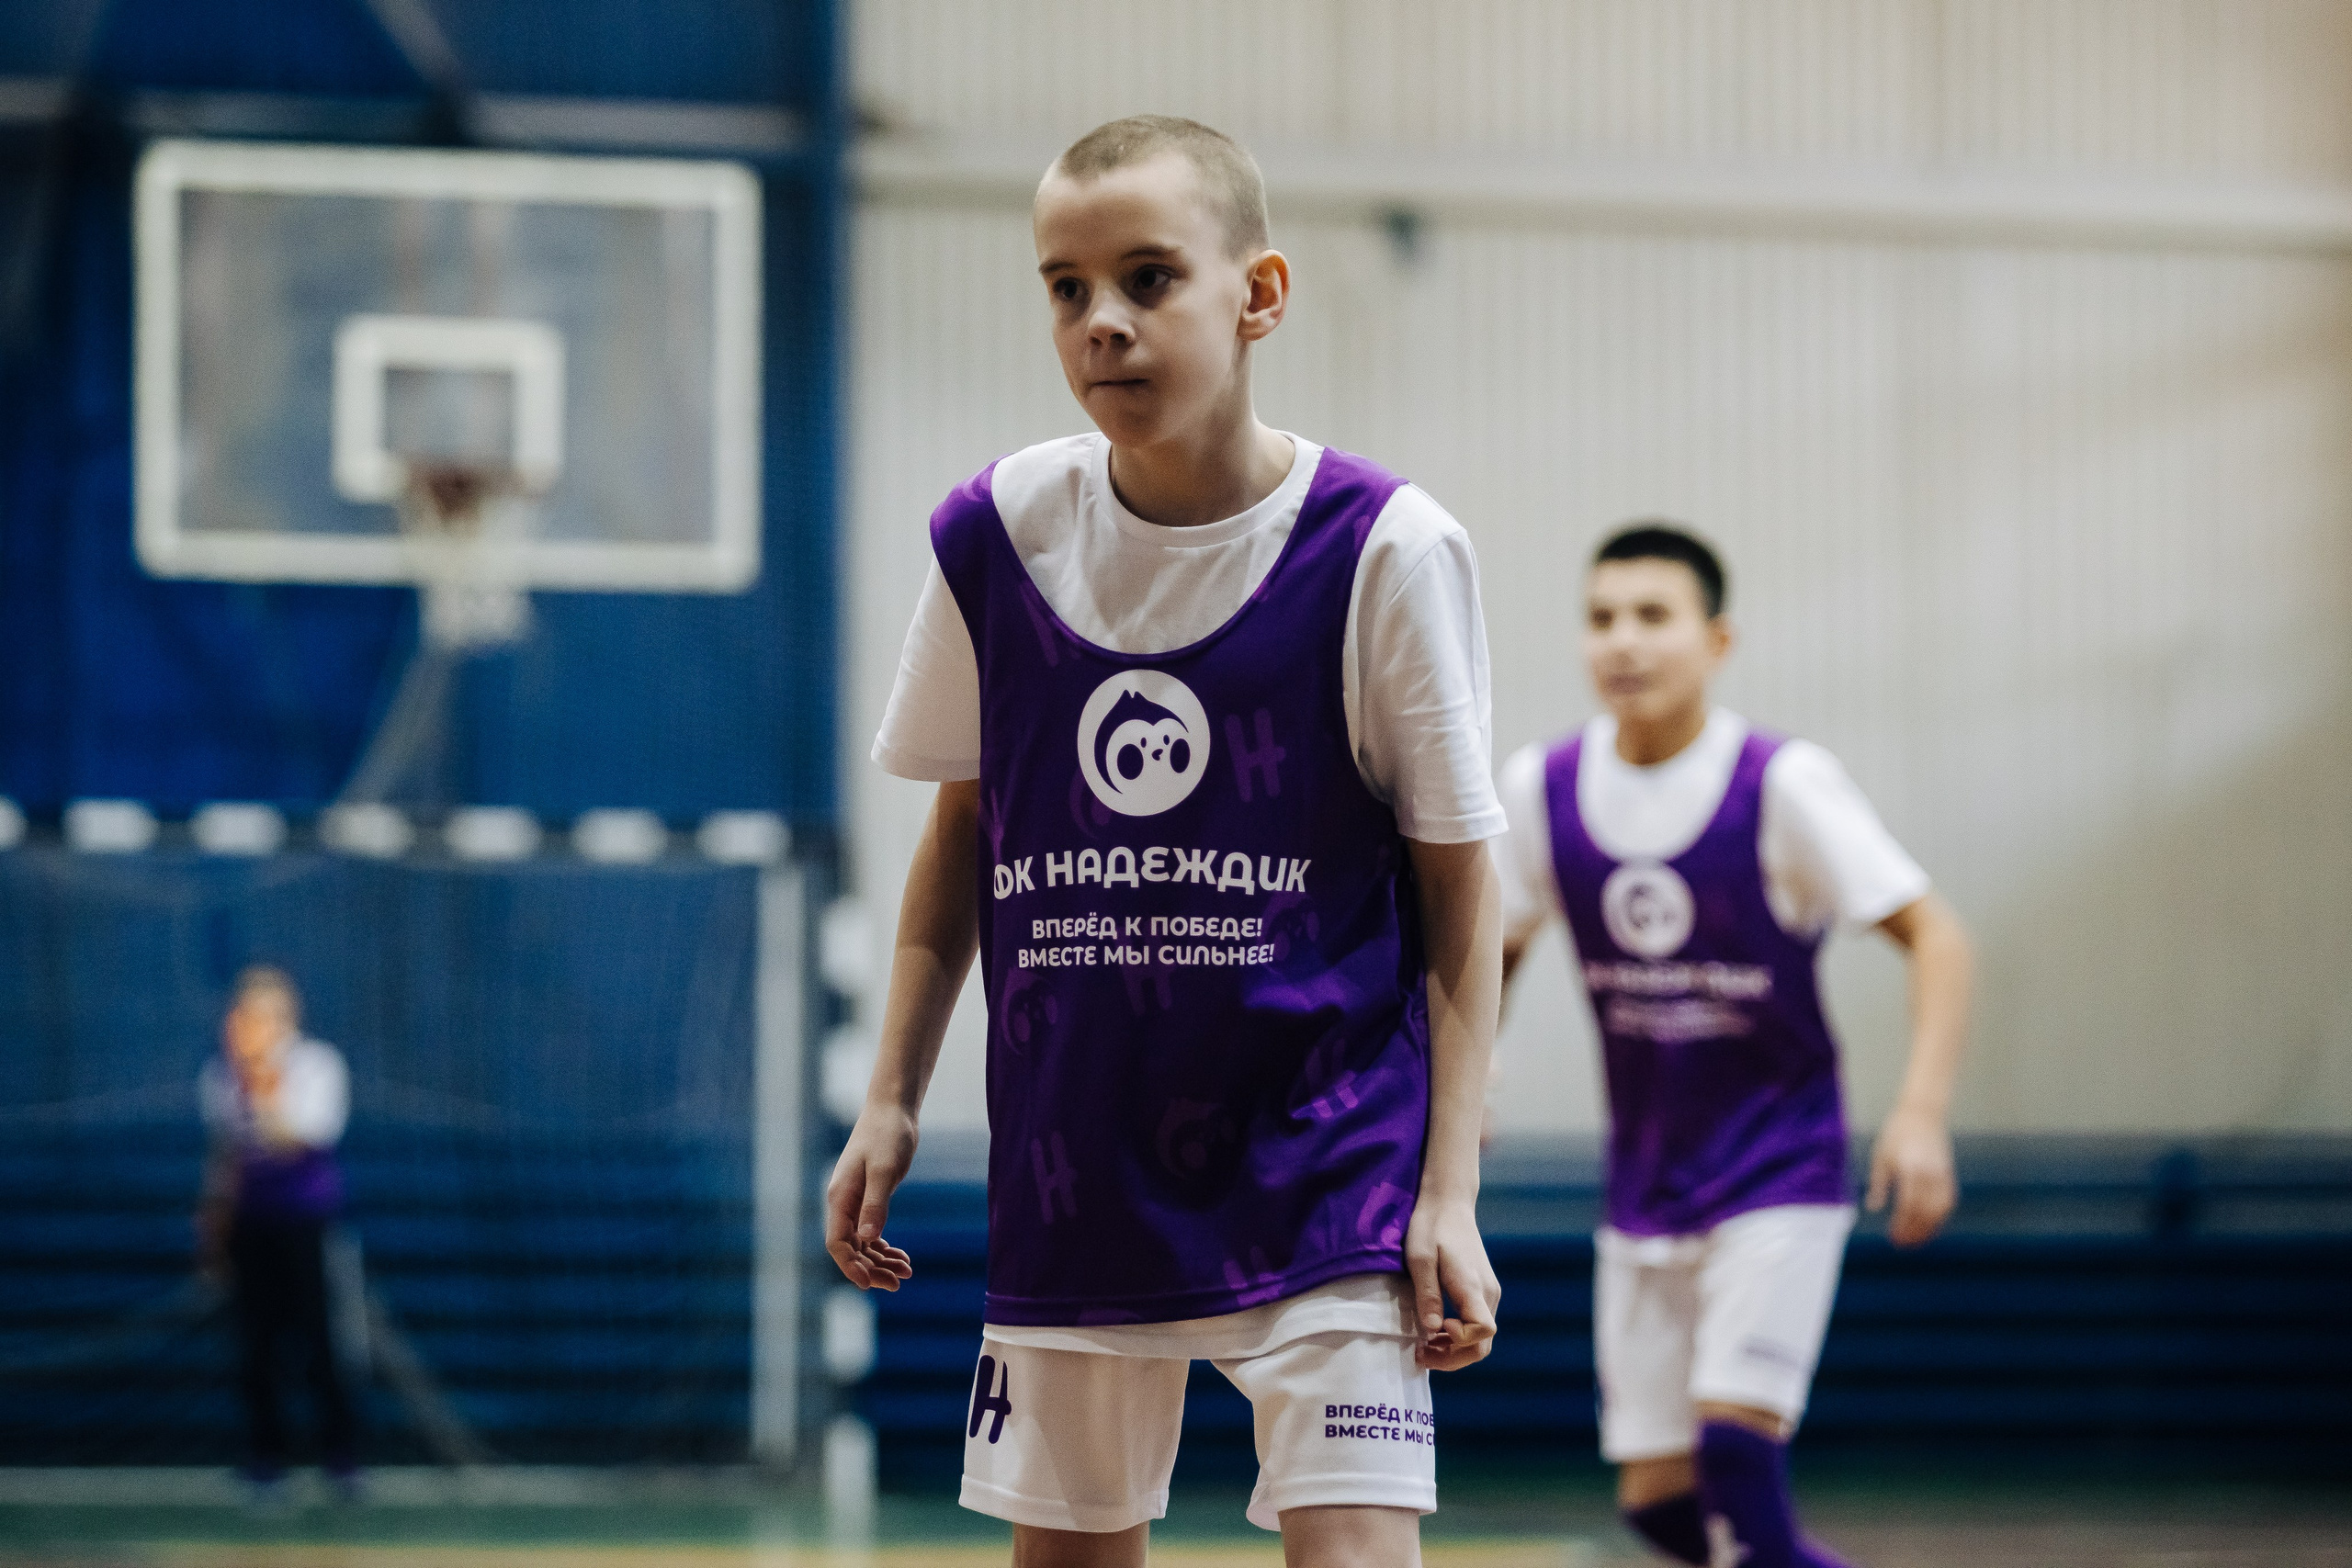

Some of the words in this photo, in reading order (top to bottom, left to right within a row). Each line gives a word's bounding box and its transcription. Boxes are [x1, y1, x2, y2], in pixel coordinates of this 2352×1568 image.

[994, 855, 1035, 900] ФК
[1046, 845, 1312, 896] НАДЕЖДИК
[1032, 912, 1118, 940] ВПЕРЁД
[1125, 917, 1142, 937] К
[1150, 916, 1263, 941] ПОБЕДЕ!
[1018, 945, 1097, 968] ВМЕСТЕ
[1103, 945, 1150, 965] МЫ
[1158, 943, 1275, 966] СИЛЬНЕЕ!
[1325, 1403, 1401, 1424] ВПЕРЁД
[1404, 1408, 1413, 1423] К
[1325, 1424, 1400, 1440] ВМЕСТЕ
[1405, 1428, 1423, 1445] МЫ
[1426, 1432, 1435, 1446] С
